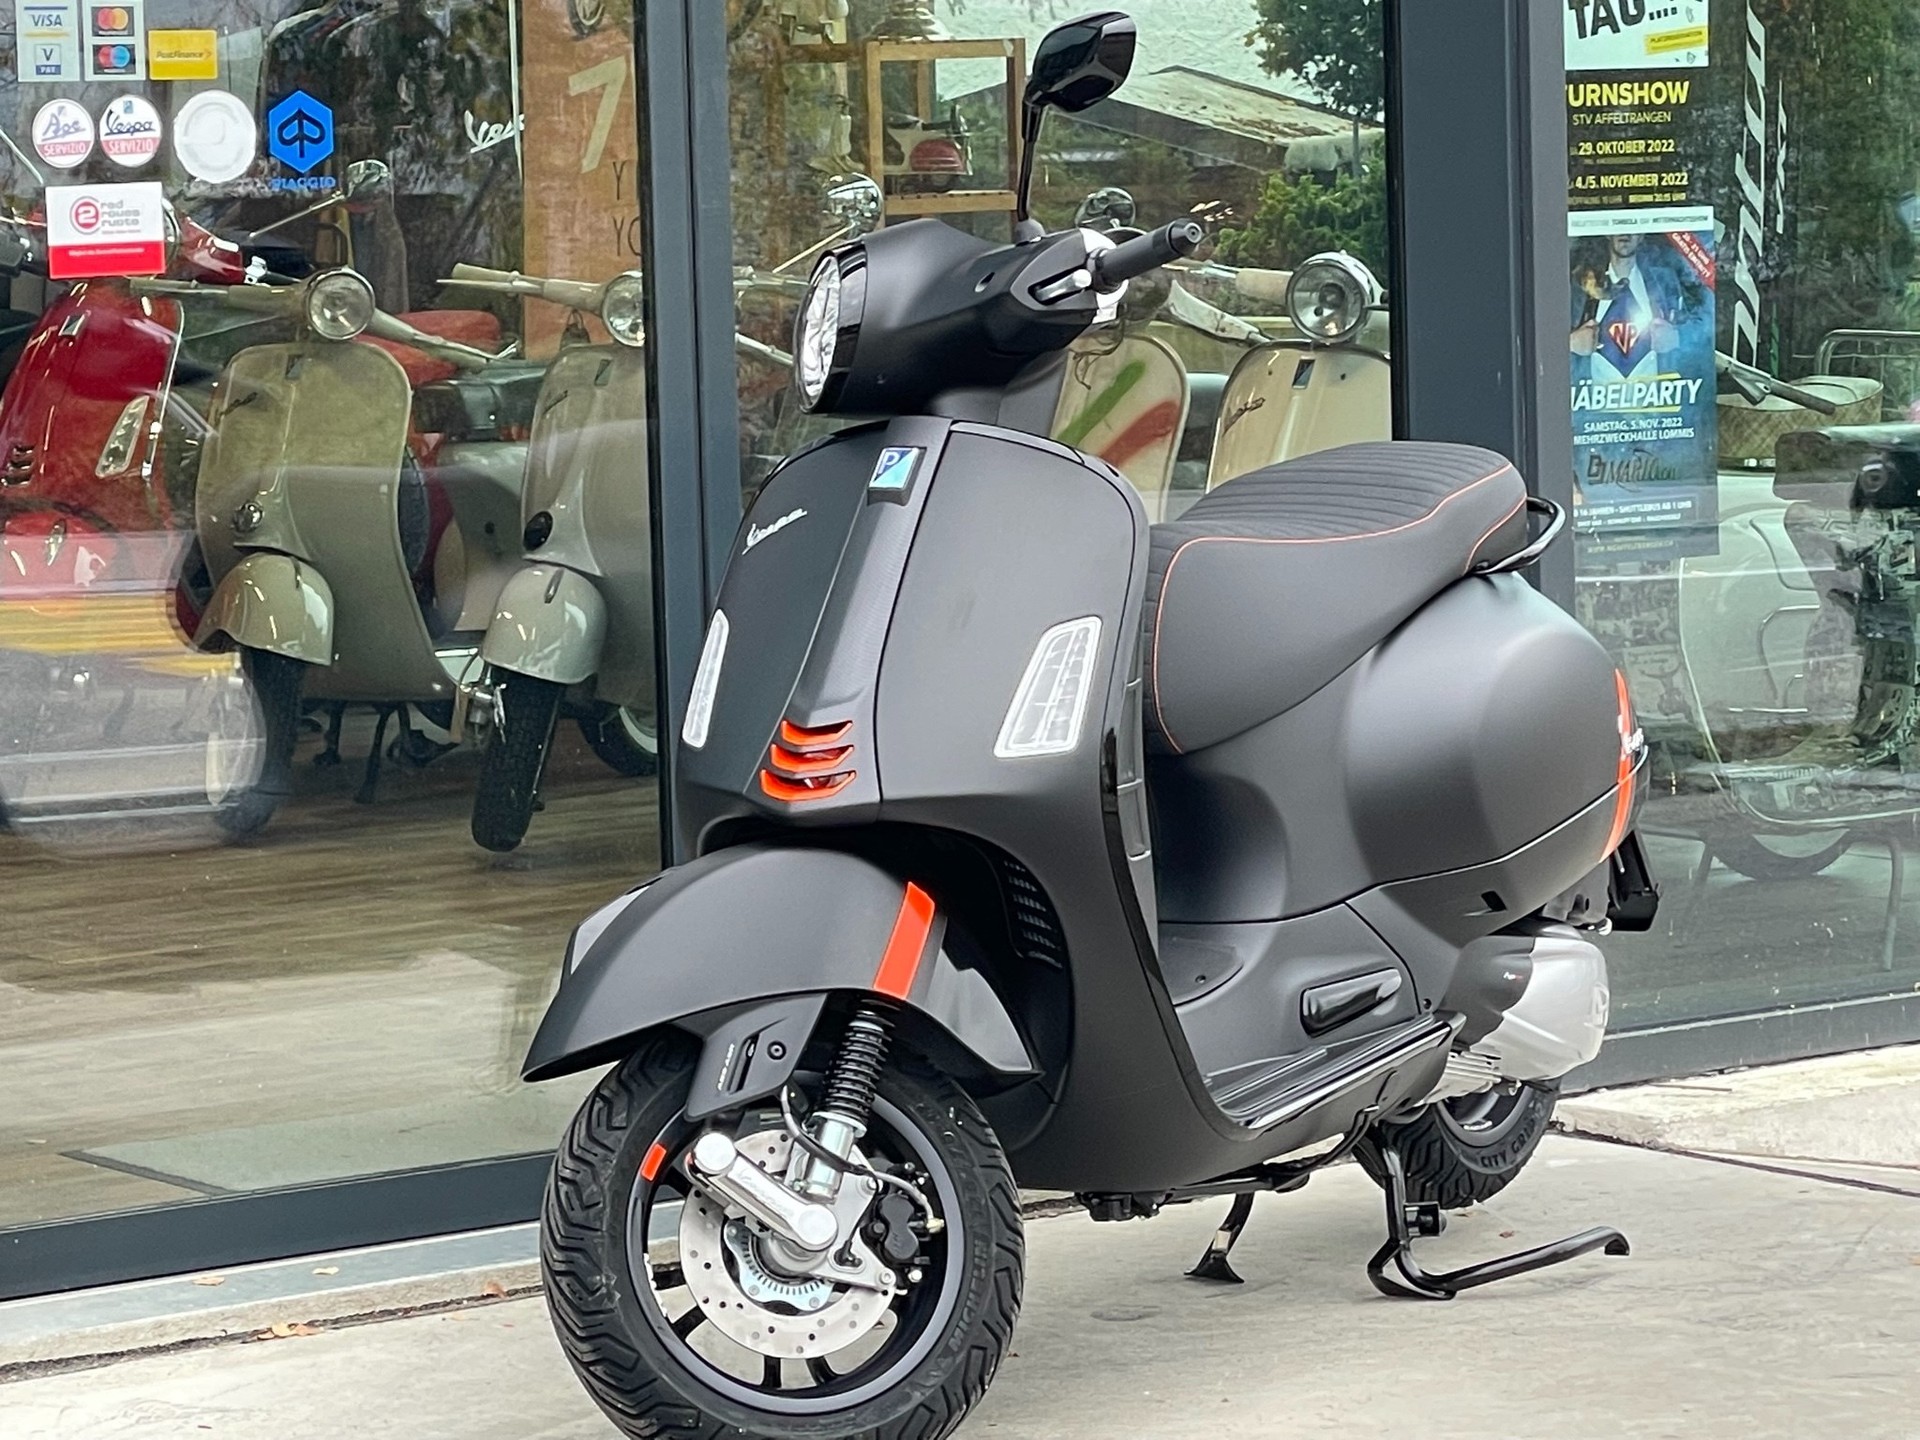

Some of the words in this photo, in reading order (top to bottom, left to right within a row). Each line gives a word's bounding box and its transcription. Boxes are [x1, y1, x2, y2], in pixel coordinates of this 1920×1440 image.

[32, 14, 63, 27] VISA
[42, 48, 54, 61] V
[1565, 80, 1690, 107] URNSHOW
[104, 109, 156, 136] Vespa
[568, 55, 627, 174] 7
[43, 143, 86, 156] SERVIZIO
[108, 139, 153, 155] SERVIZIO
[1578, 142, 1596, 155] 29.
[1596, 139, 1646, 155] OKTOBER
[1647, 139, 1675, 153] 2022
[270, 176, 336, 191] PIAGGIO
[1600, 174, 1659, 188] NOVEMBER
[1661, 172, 1689, 186] 2022
[1480, 1150, 1507, 1168] CITY
